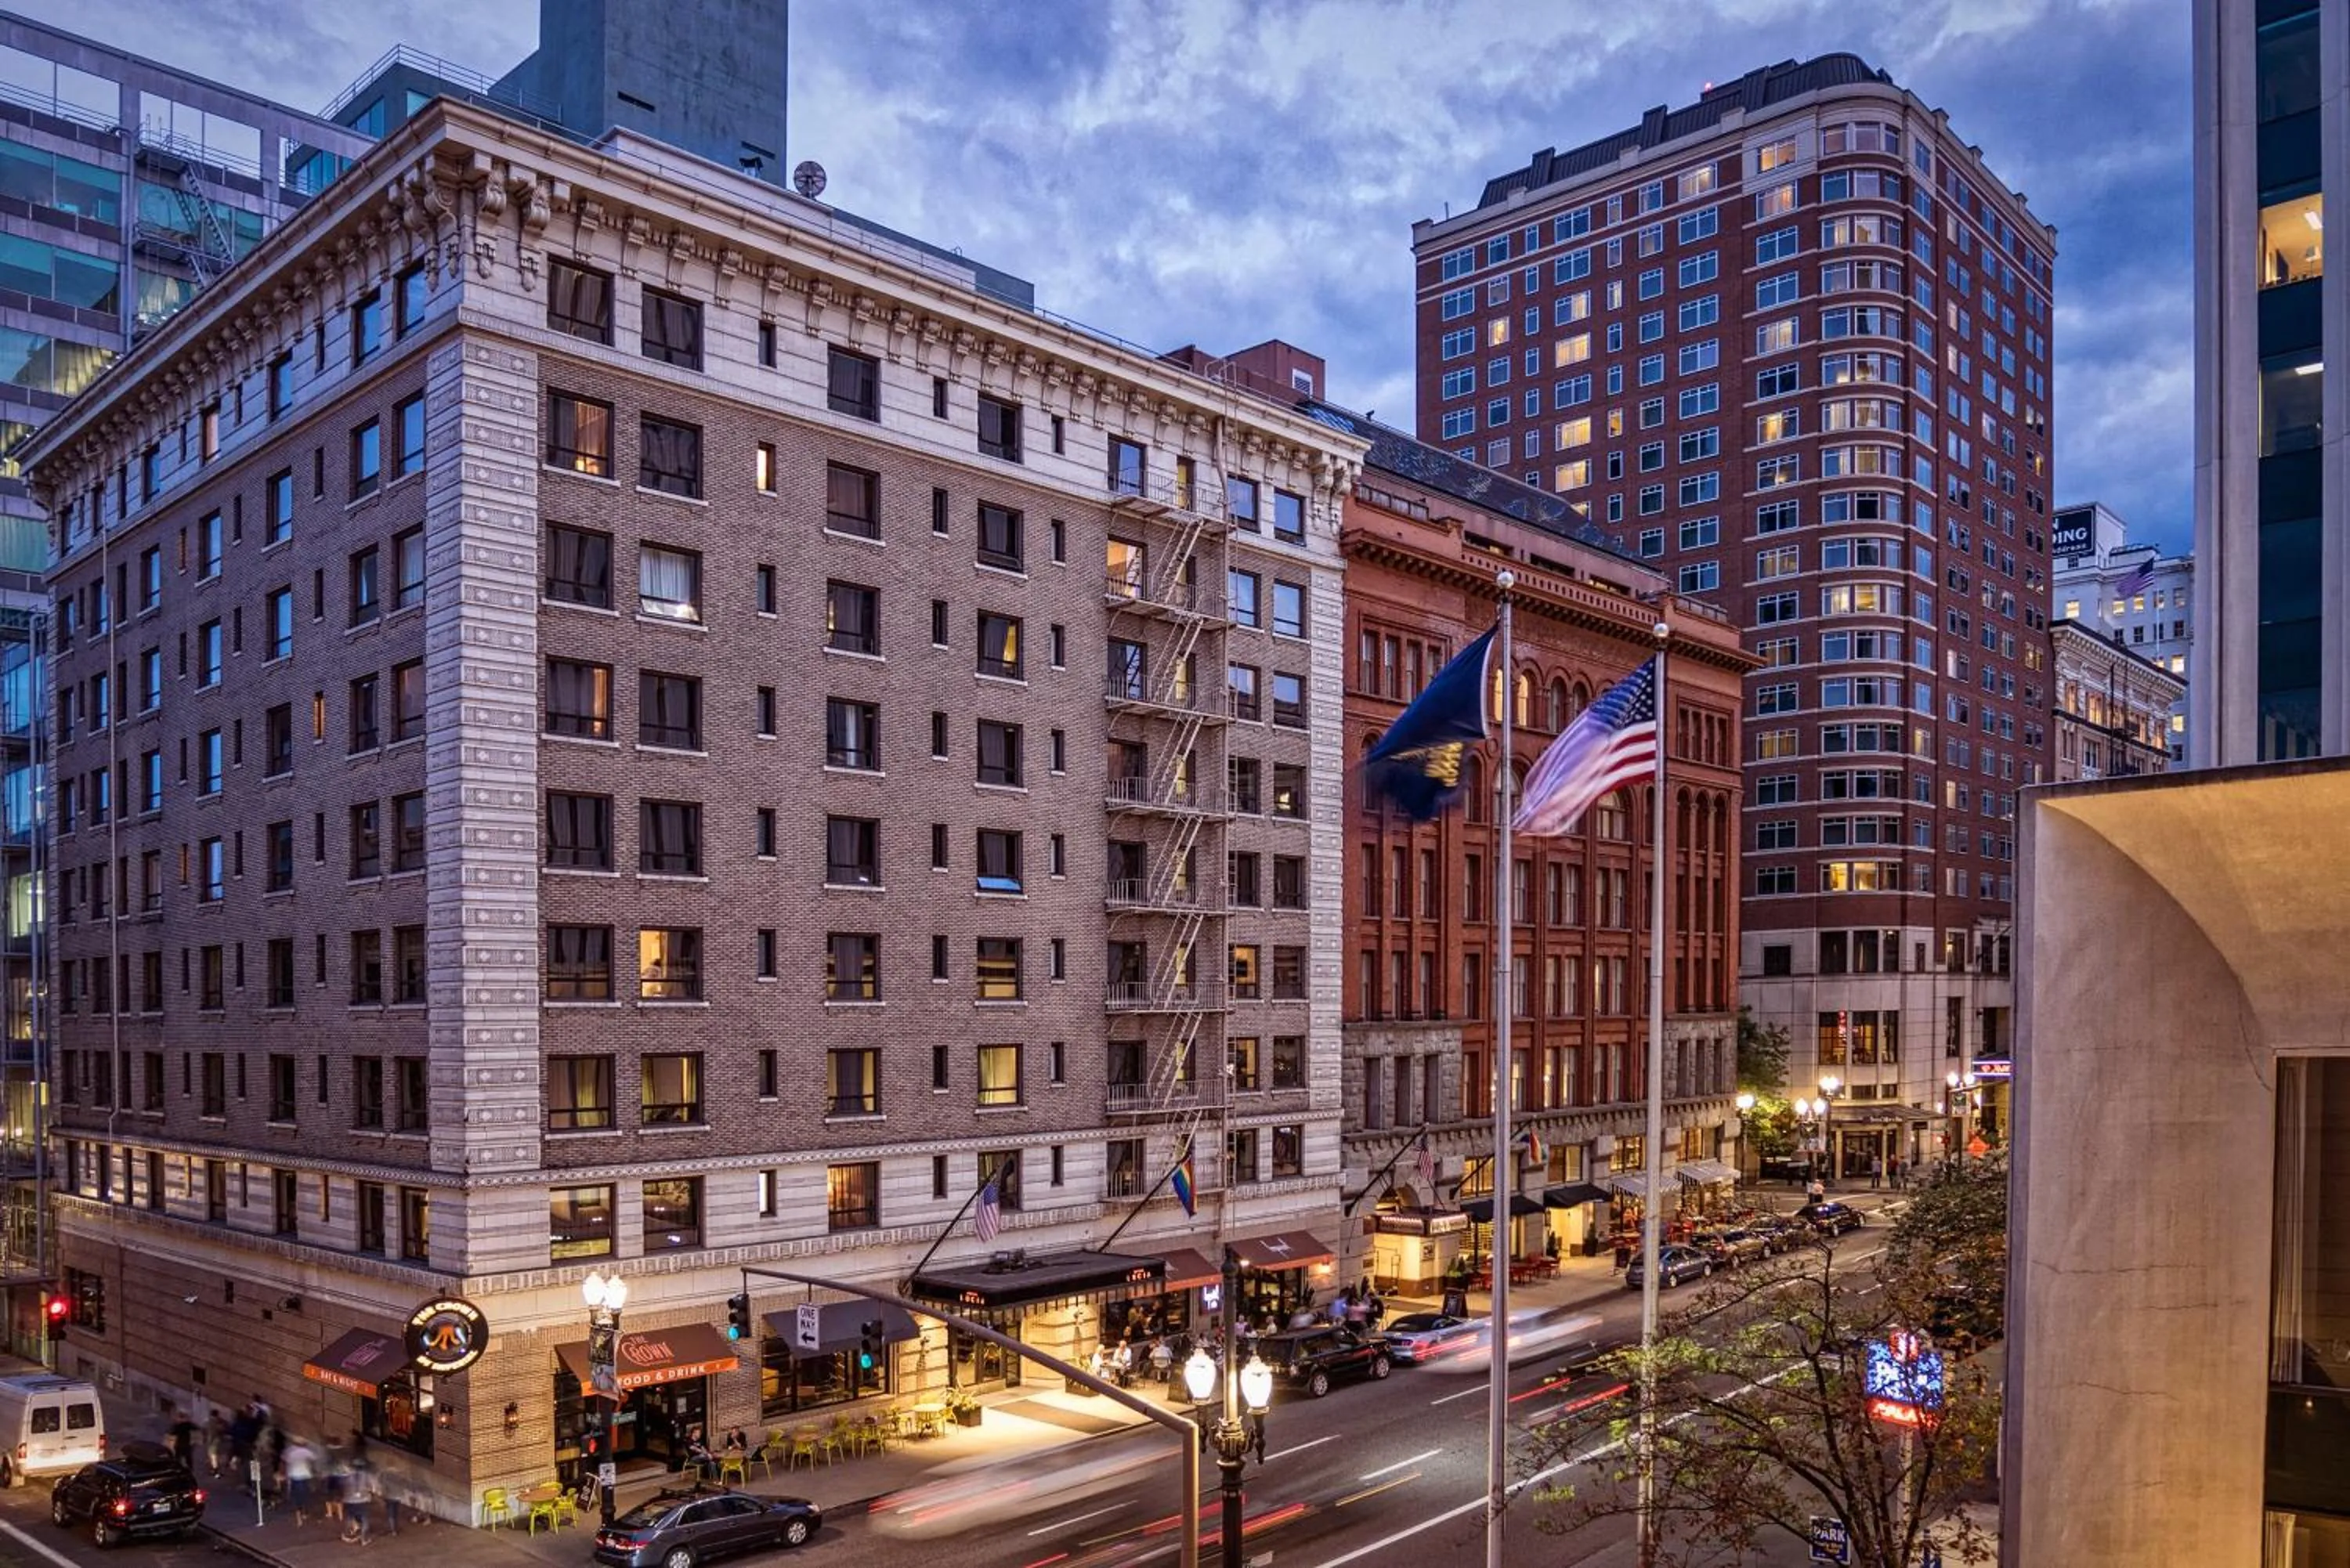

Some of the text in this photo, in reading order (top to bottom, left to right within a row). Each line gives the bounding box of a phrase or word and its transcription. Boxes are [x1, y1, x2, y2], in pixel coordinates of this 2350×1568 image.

[411, 1306, 436, 1326] THE
[800, 1308, 815, 1319] ONE
[800, 1320, 815, 1330] WAY
[628, 1334, 648, 1345] THE
[621, 1341, 675, 1367] CROWN
[656, 1372, 665, 1382] &
[668, 1365, 706, 1378] DRINK
